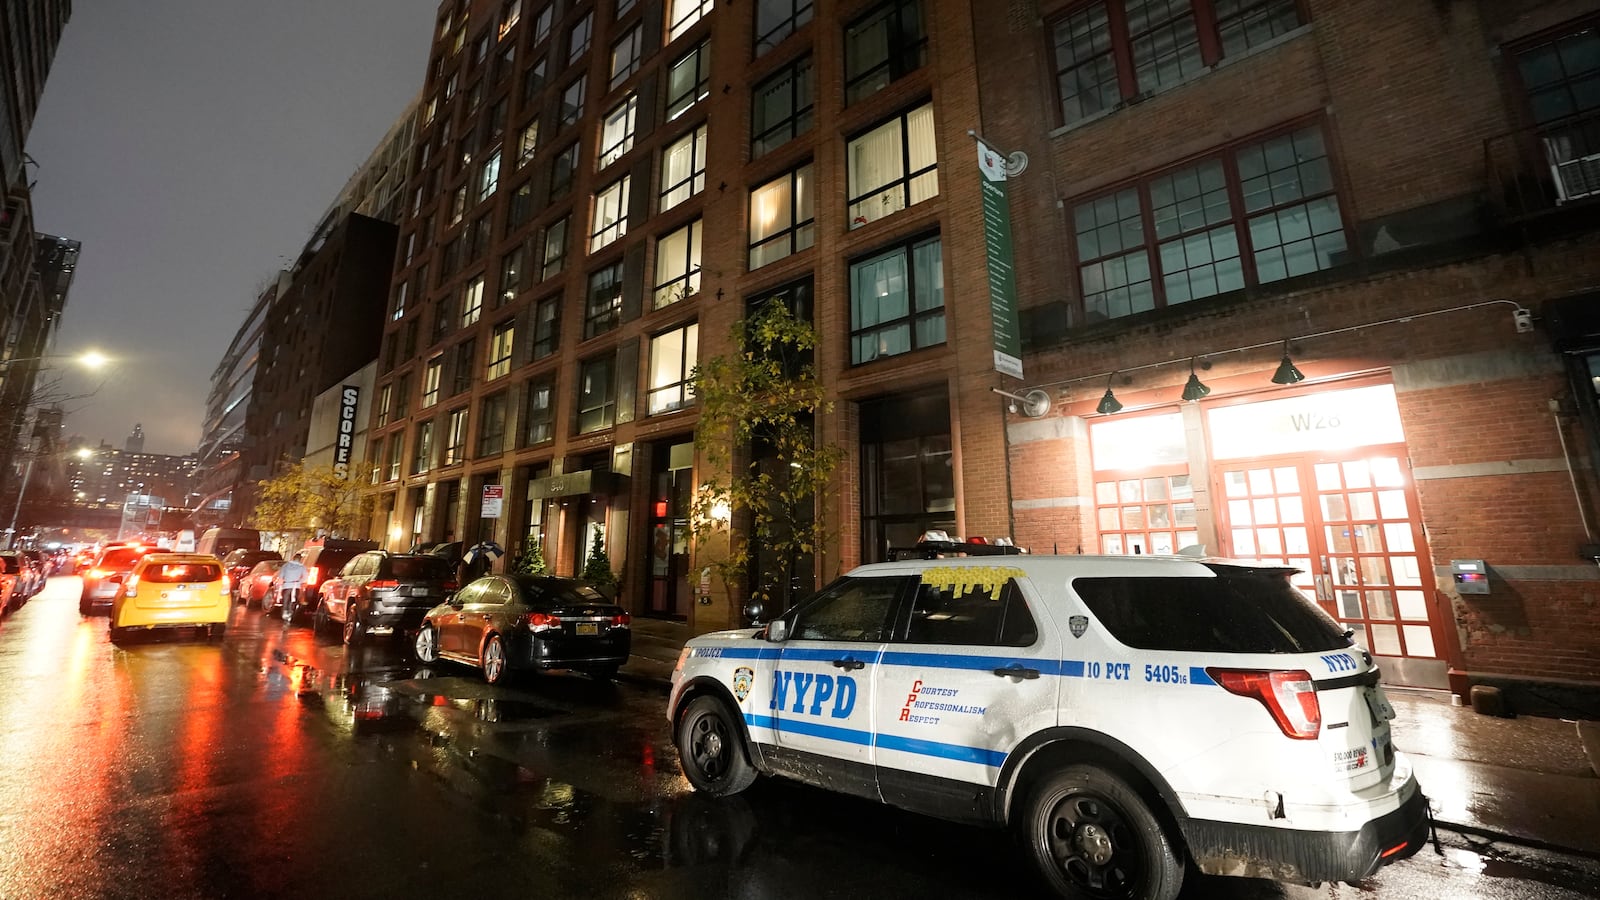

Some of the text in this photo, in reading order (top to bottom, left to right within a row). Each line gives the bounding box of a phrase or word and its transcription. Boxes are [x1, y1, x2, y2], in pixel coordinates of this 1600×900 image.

[334, 388, 358, 480] SCORES
[696, 647, 722, 658] POLICE
[1087, 662, 1100, 679] 10
[1106, 662, 1131, 680] PCT
[1320, 653, 1357, 672] NYPD
[769, 670, 857, 719] NYPD
[912, 680, 959, 697] COURTESY
[905, 694, 988, 715] PROFESSIONALISM
[899, 708, 940, 725] RESPECT
